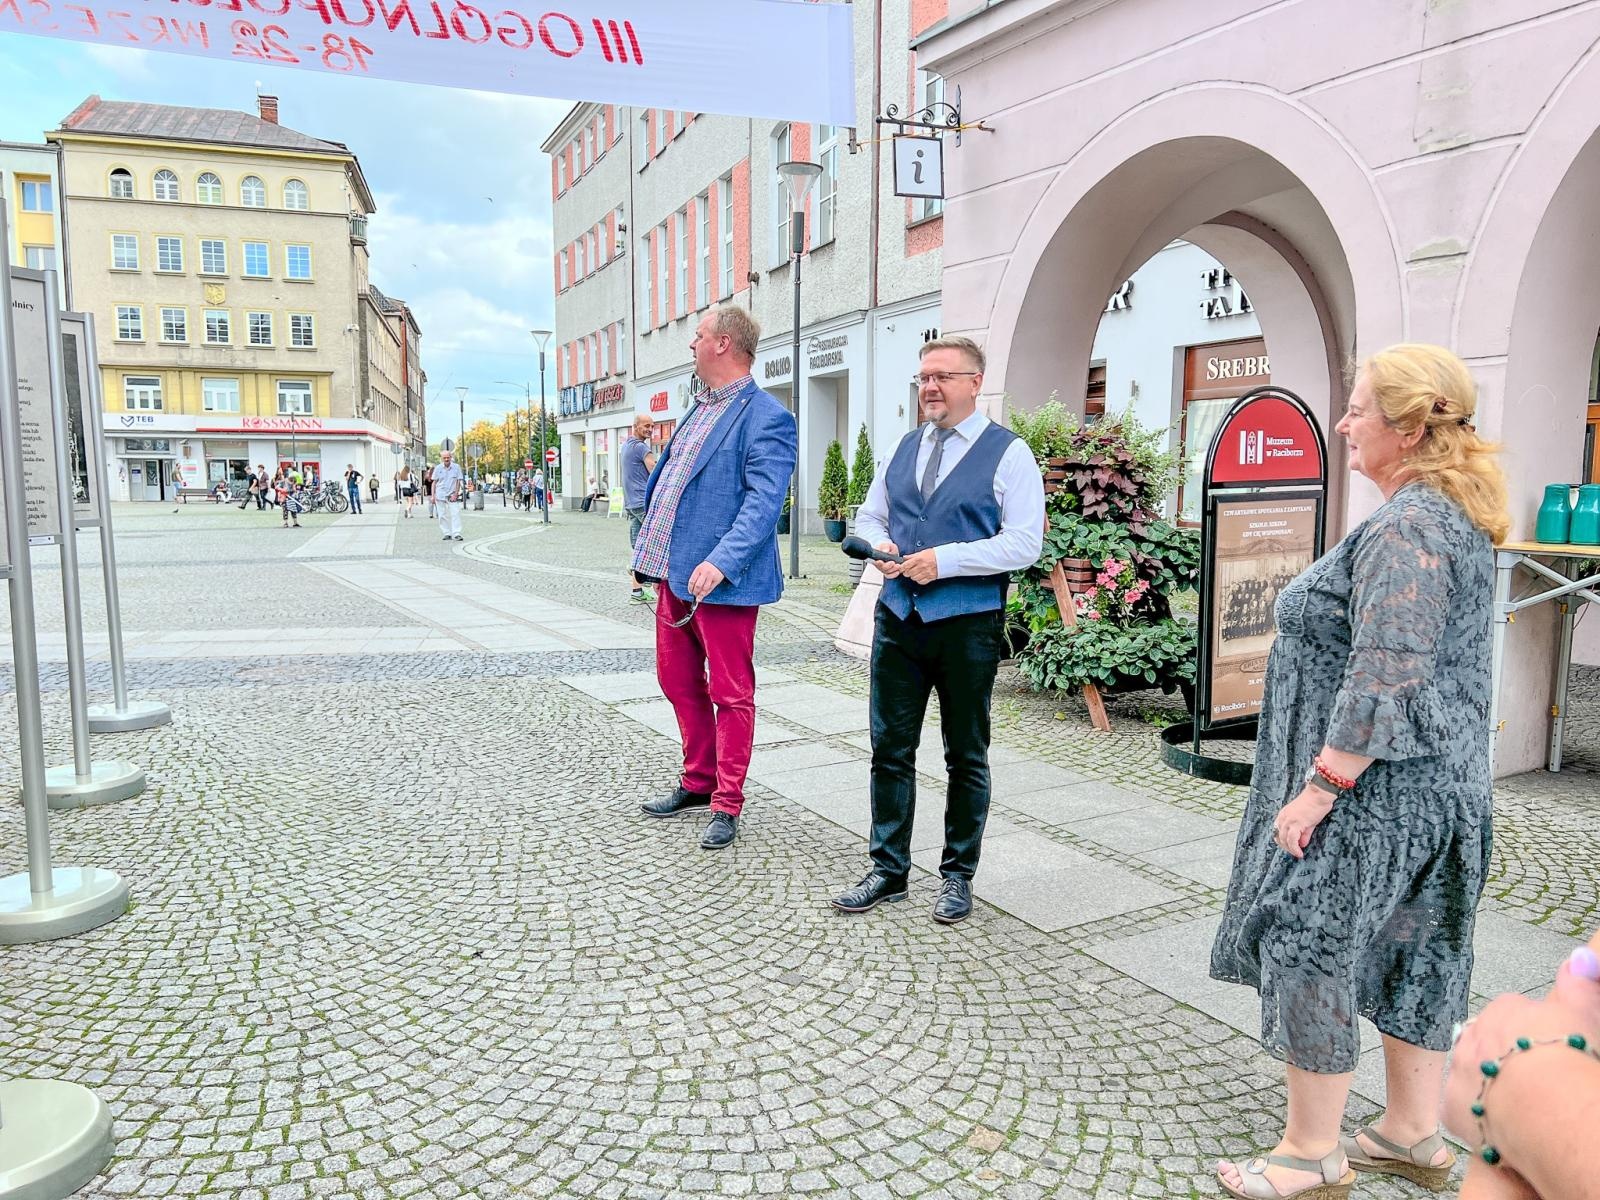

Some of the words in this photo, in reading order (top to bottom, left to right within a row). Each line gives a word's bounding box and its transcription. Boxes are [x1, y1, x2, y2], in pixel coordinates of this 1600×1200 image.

[911, 149, 925, 185] i
[765, 356, 792, 379] BOLKO
[136, 415, 154, 423] TEB
[242, 416, 322, 429] ROSSMANN
[1266, 437, 1294, 446] Muzeum
[1273, 448, 1304, 457] Raciborzu
